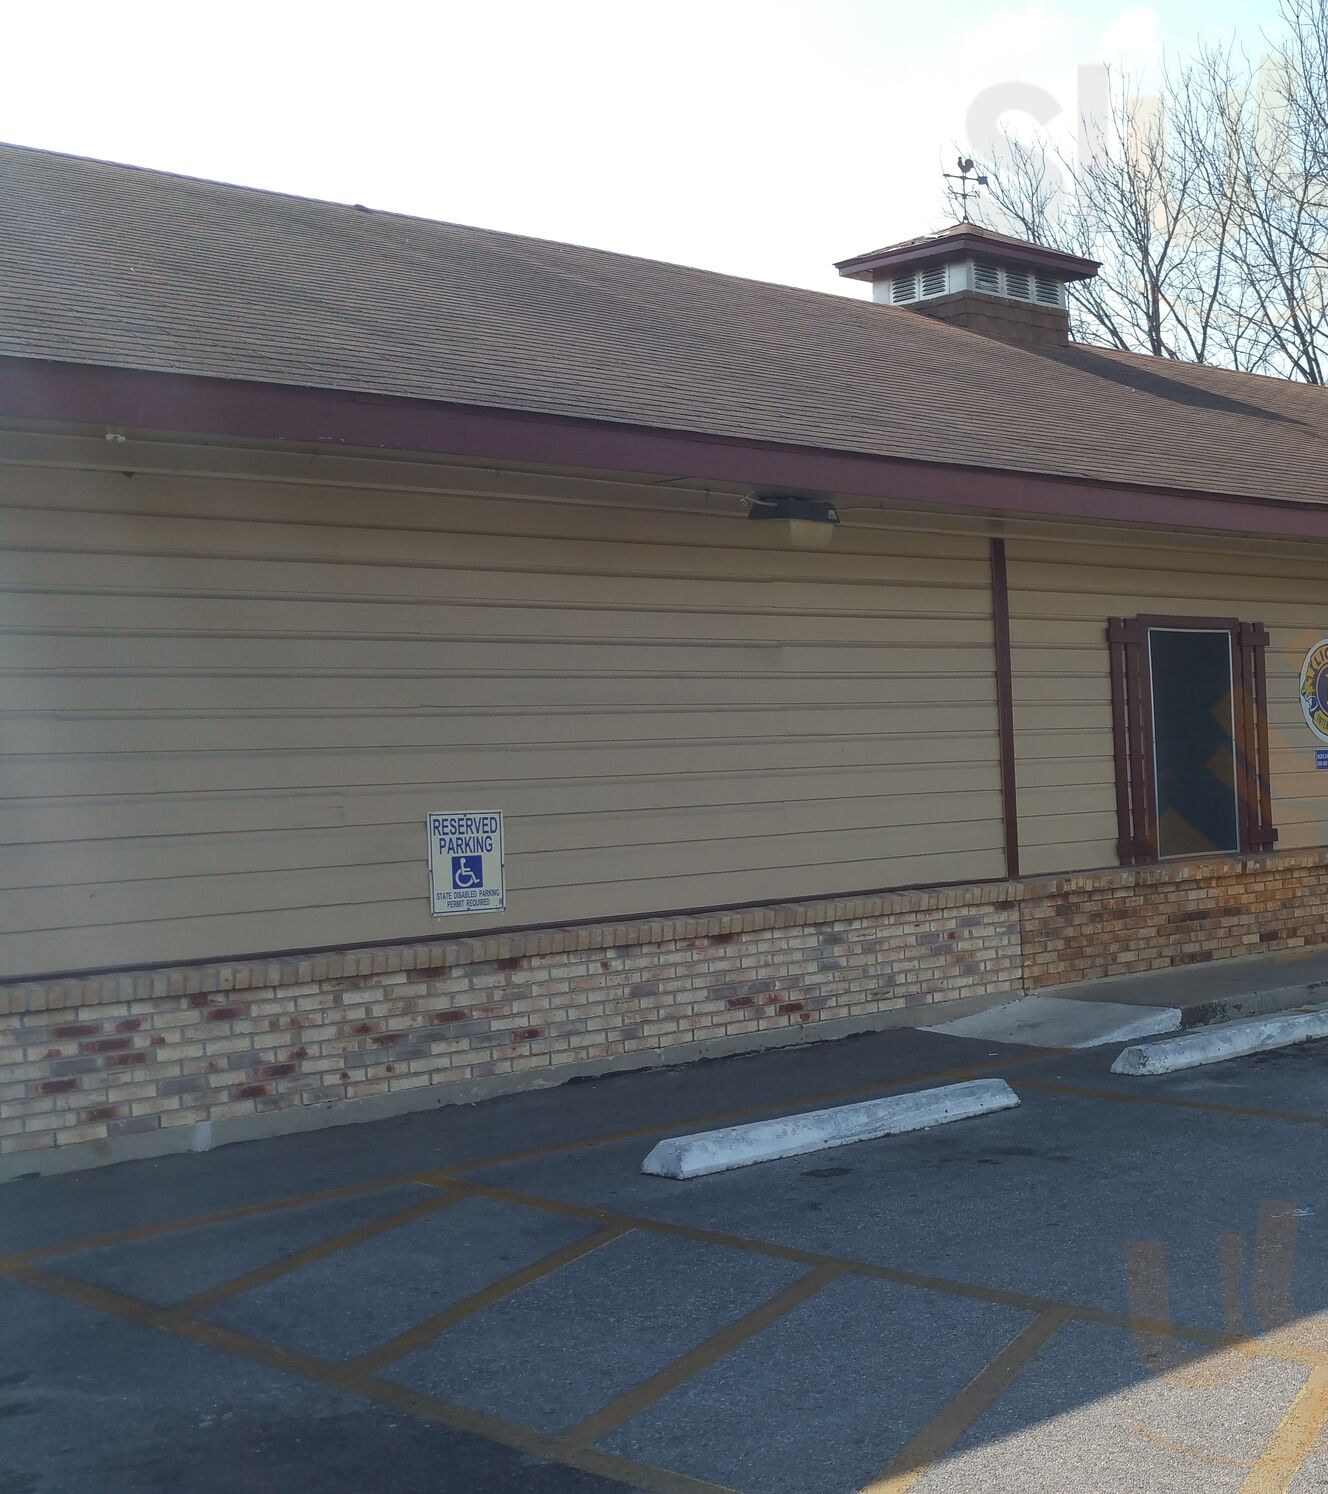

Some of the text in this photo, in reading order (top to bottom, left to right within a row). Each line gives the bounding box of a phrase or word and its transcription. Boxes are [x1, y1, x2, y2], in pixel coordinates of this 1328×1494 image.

[433, 816, 498, 836] RESERVED
[439, 836, 493, 855] PARKING
[436, 889, 500, 900] STATE DISABLED PARKING
[447, 900, 464, 908] PERMIT
[466, 898, 491, 907] REQUIRED
